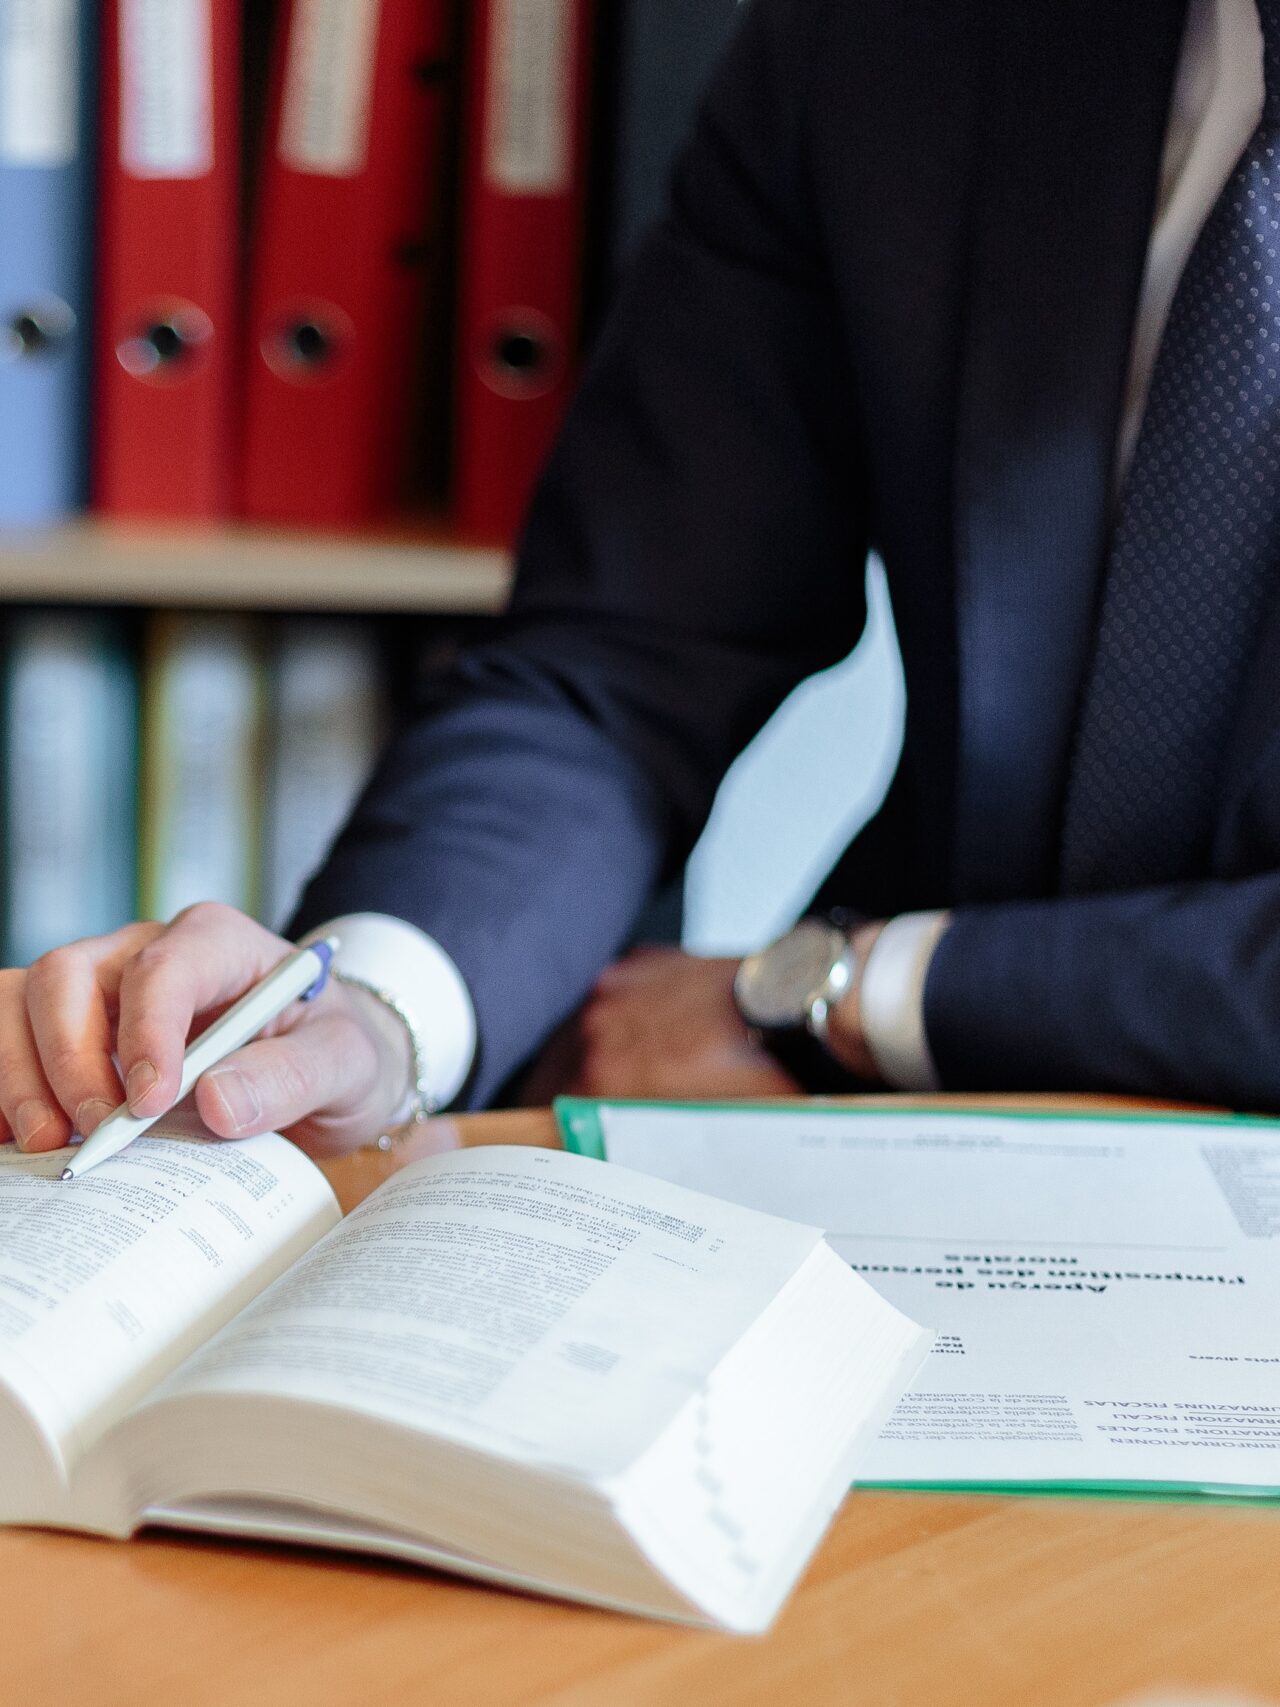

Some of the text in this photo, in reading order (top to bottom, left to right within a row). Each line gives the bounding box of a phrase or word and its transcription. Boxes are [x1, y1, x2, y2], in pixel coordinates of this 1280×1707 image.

[944, 1255, 1078, 1264] morales
[977, 1269, 1036, 1278] des
[936, 1281, 1107, 1294] Aperçu de
[1084, 1400, 1168, 1408] FISCALAS
[1112, 1413, 1280, 1424] RMAZIONI FISCALI
[1109, 1438, 1280, 1449] RINFORMATIONEN
